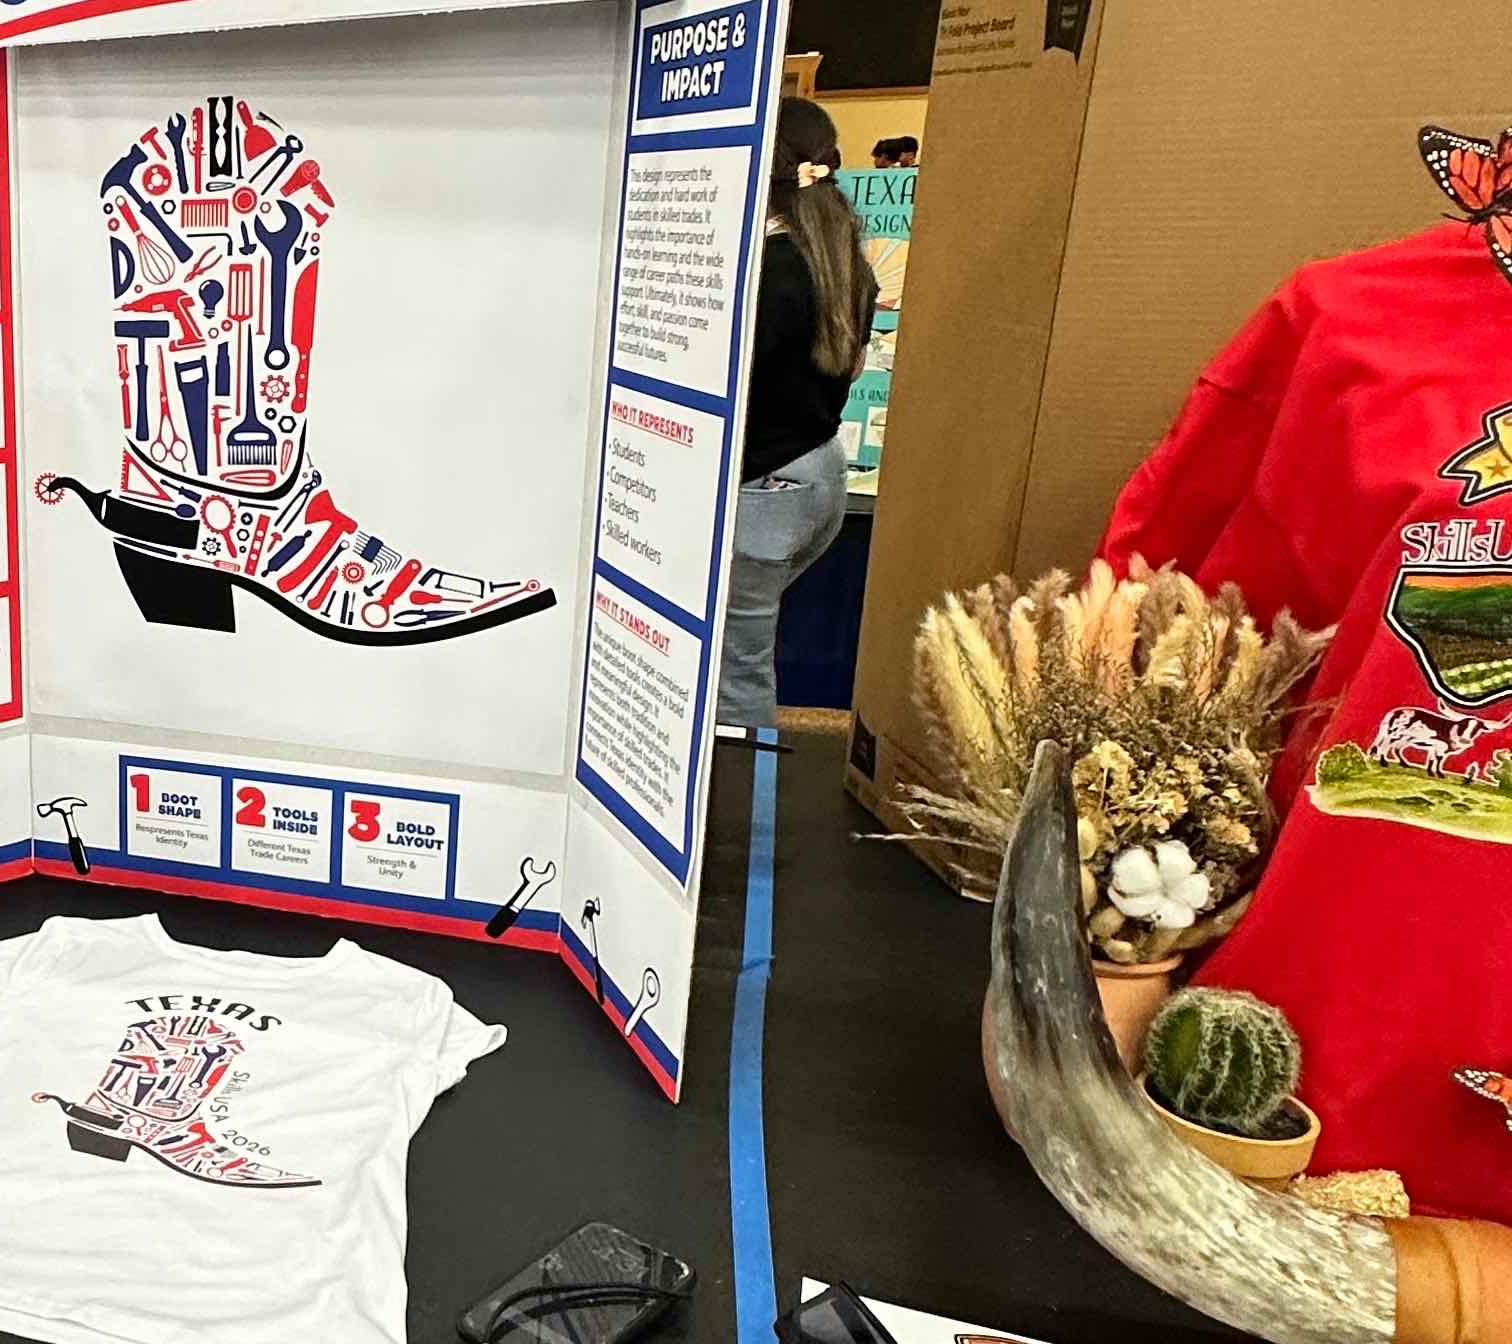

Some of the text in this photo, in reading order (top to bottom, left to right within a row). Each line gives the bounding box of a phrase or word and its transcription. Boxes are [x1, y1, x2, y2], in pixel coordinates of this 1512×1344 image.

[650, 12, 745, 64] PURPOSE &
[661, 61, 724, 102] IMPACT
[851, 174, 917, 206] TEXA
[620, 608, 670, 652] STANDS OUT
[130, 773, 150, 812] 1
[161, 792, 198, 806] BOOT
[158, 805, 201, 819] SHAPE
[236, 787, 266, 828] 2
[272, 806, 318, 822] TOOLS
[348, 800, 380, 842] 3
[273, 820, 318, 835] INSIDE
[386, 833, 444, 850] LAYOUT
[396, 821, 435, 835] BOLD
[367, 855, 407, 869] Strength
[124, 995, 282, 1032] TEXAS
[221, 1129, 271, 1156] 2026
